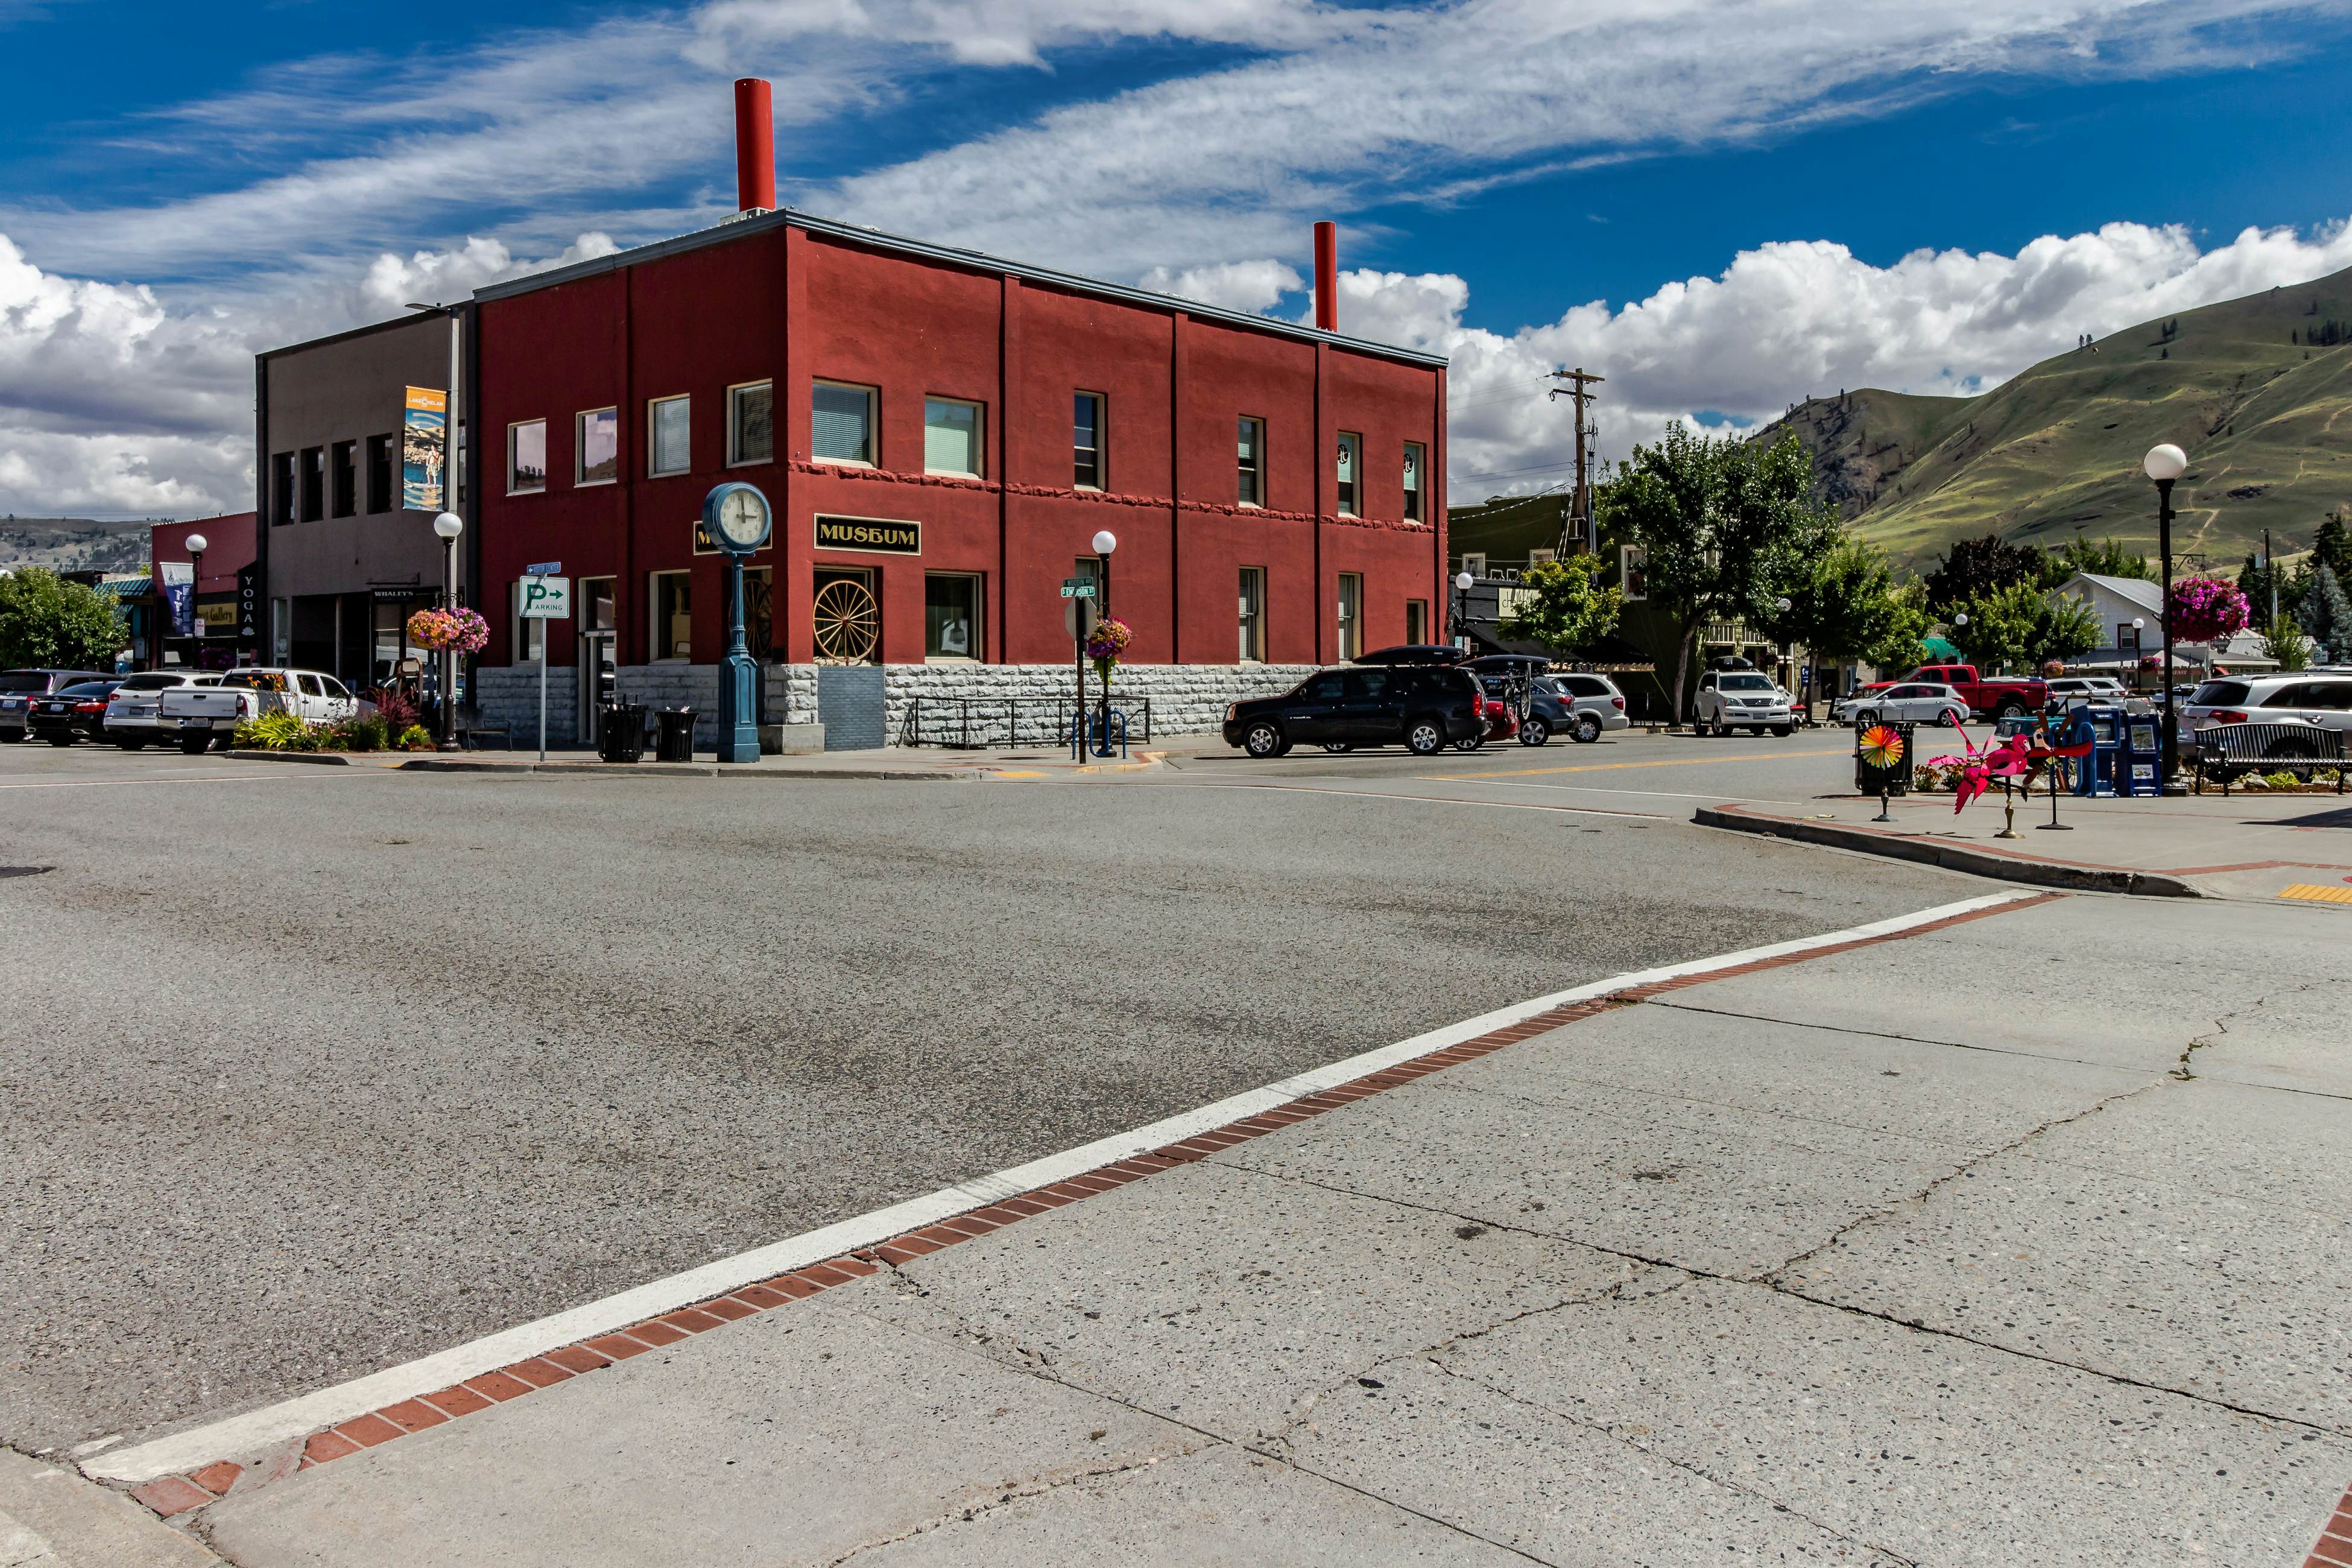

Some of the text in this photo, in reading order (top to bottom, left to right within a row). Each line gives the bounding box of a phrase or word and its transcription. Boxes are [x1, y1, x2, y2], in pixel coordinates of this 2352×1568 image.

[820, 523, 915, 545] MUSEUM
[244, 576, 254, 623] YOGA
[210, 607, 233, 623] Gallery
